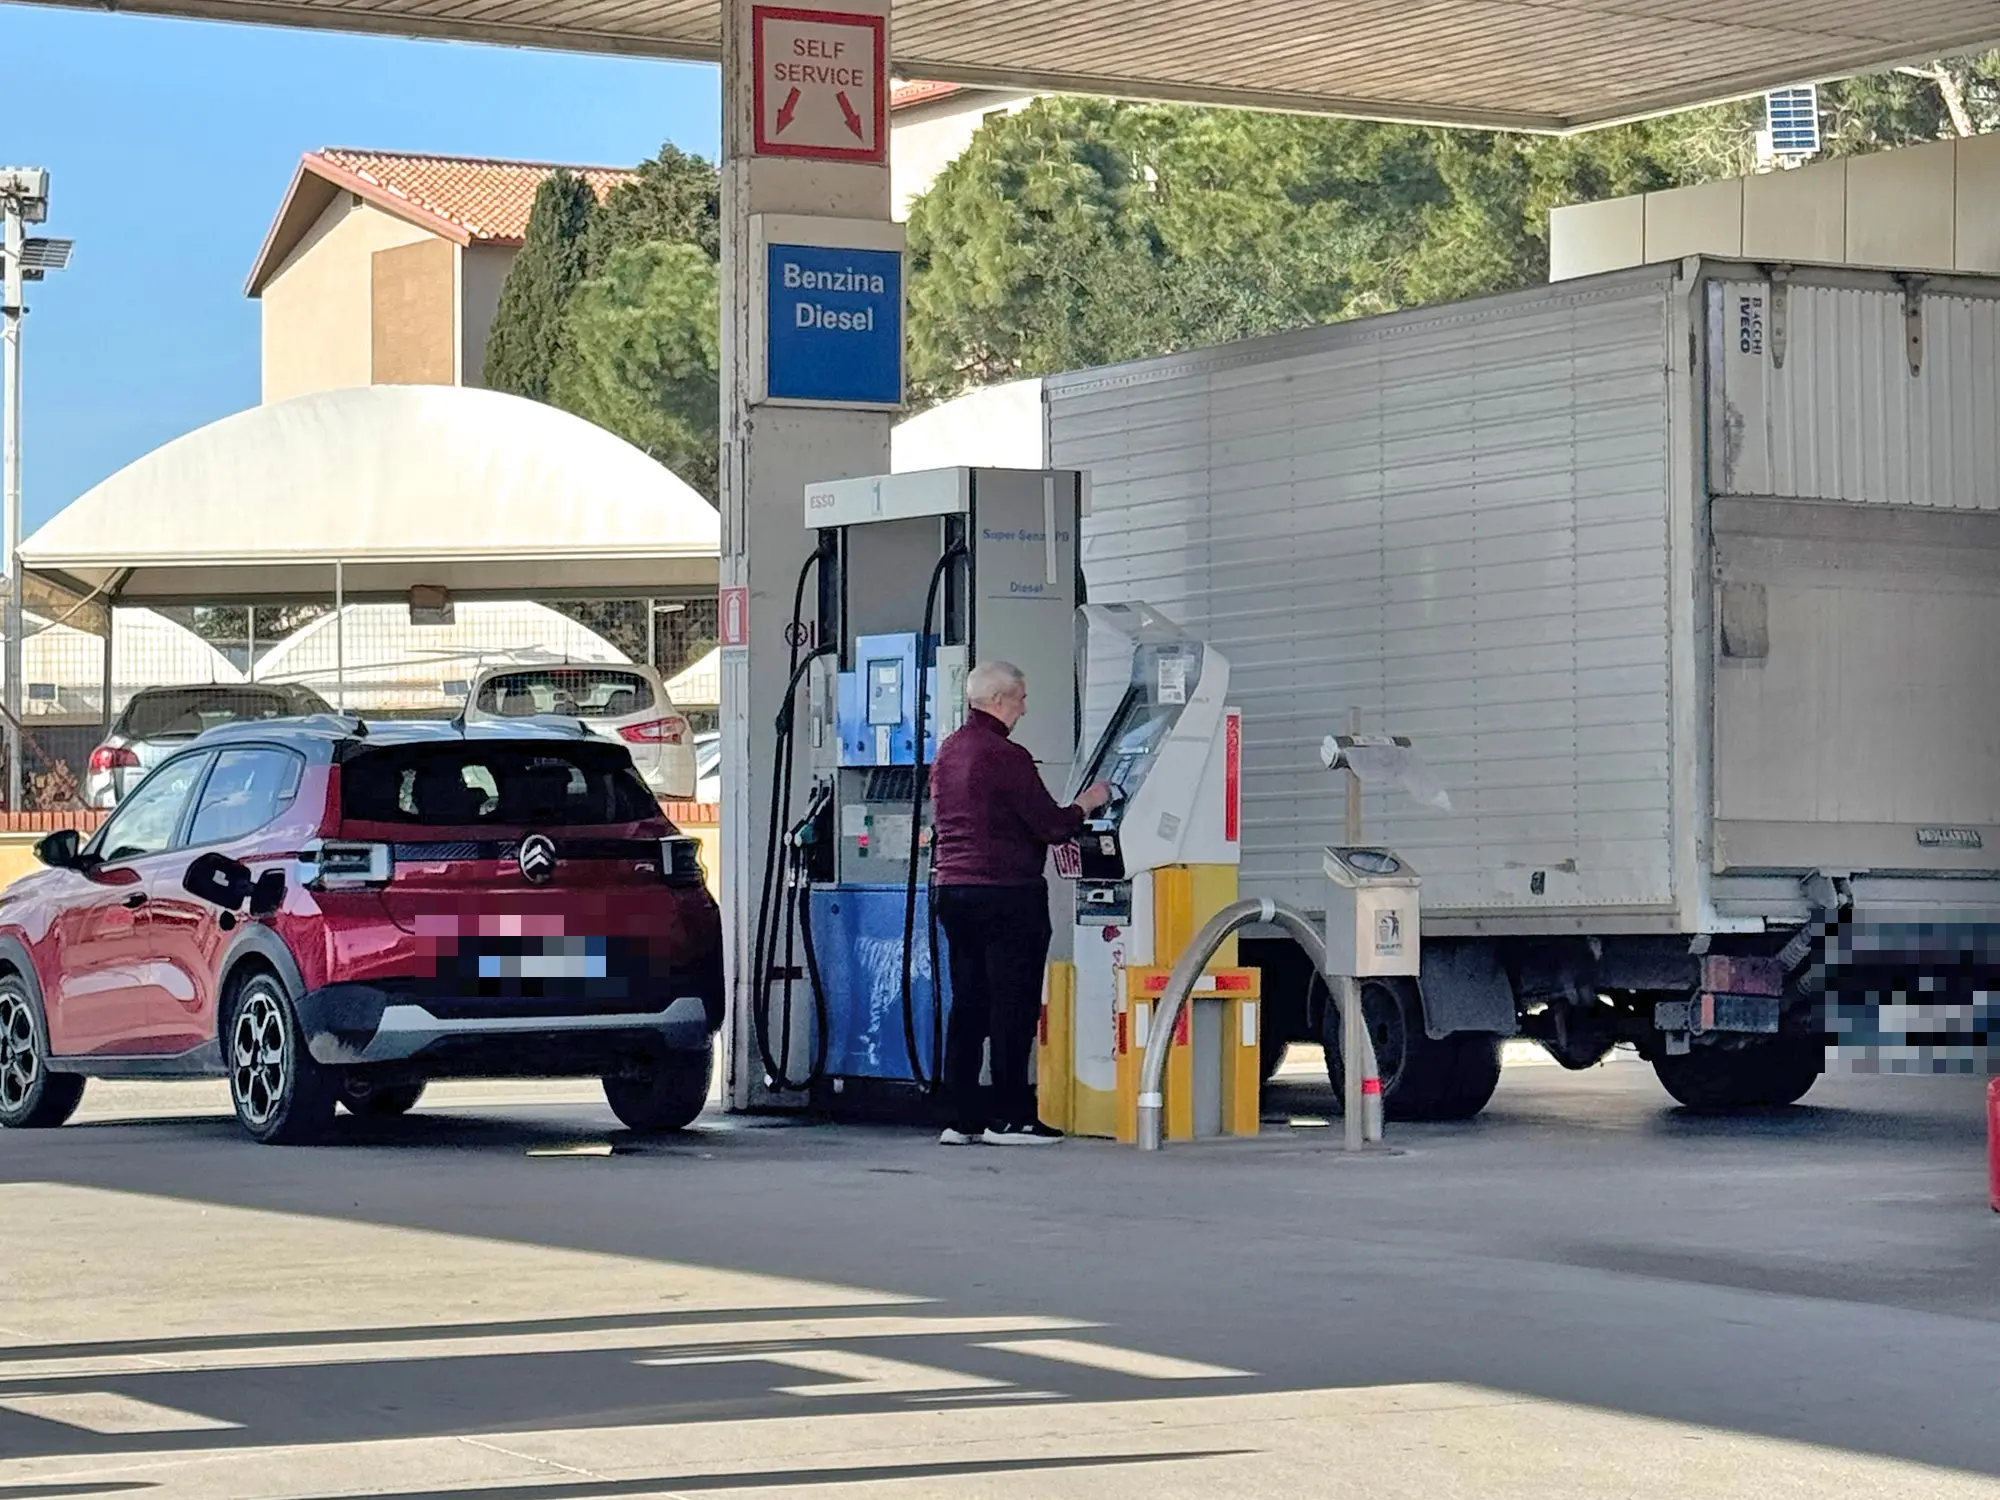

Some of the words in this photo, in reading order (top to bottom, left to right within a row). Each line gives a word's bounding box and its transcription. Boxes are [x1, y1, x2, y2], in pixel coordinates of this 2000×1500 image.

[793, 38, 847, 59] SELF
[774, 64, 864, 87] SERVICE
[784, 263, 886, 294] Benzina
[796, 302, 874, 332] Diesel
[1741, 297, 1750, 353] IVECO
[810, 495, 835, 508] ESSO
[983, 528, 1014, 543] Super
[1010, 581, 1044, 593] Diesel
